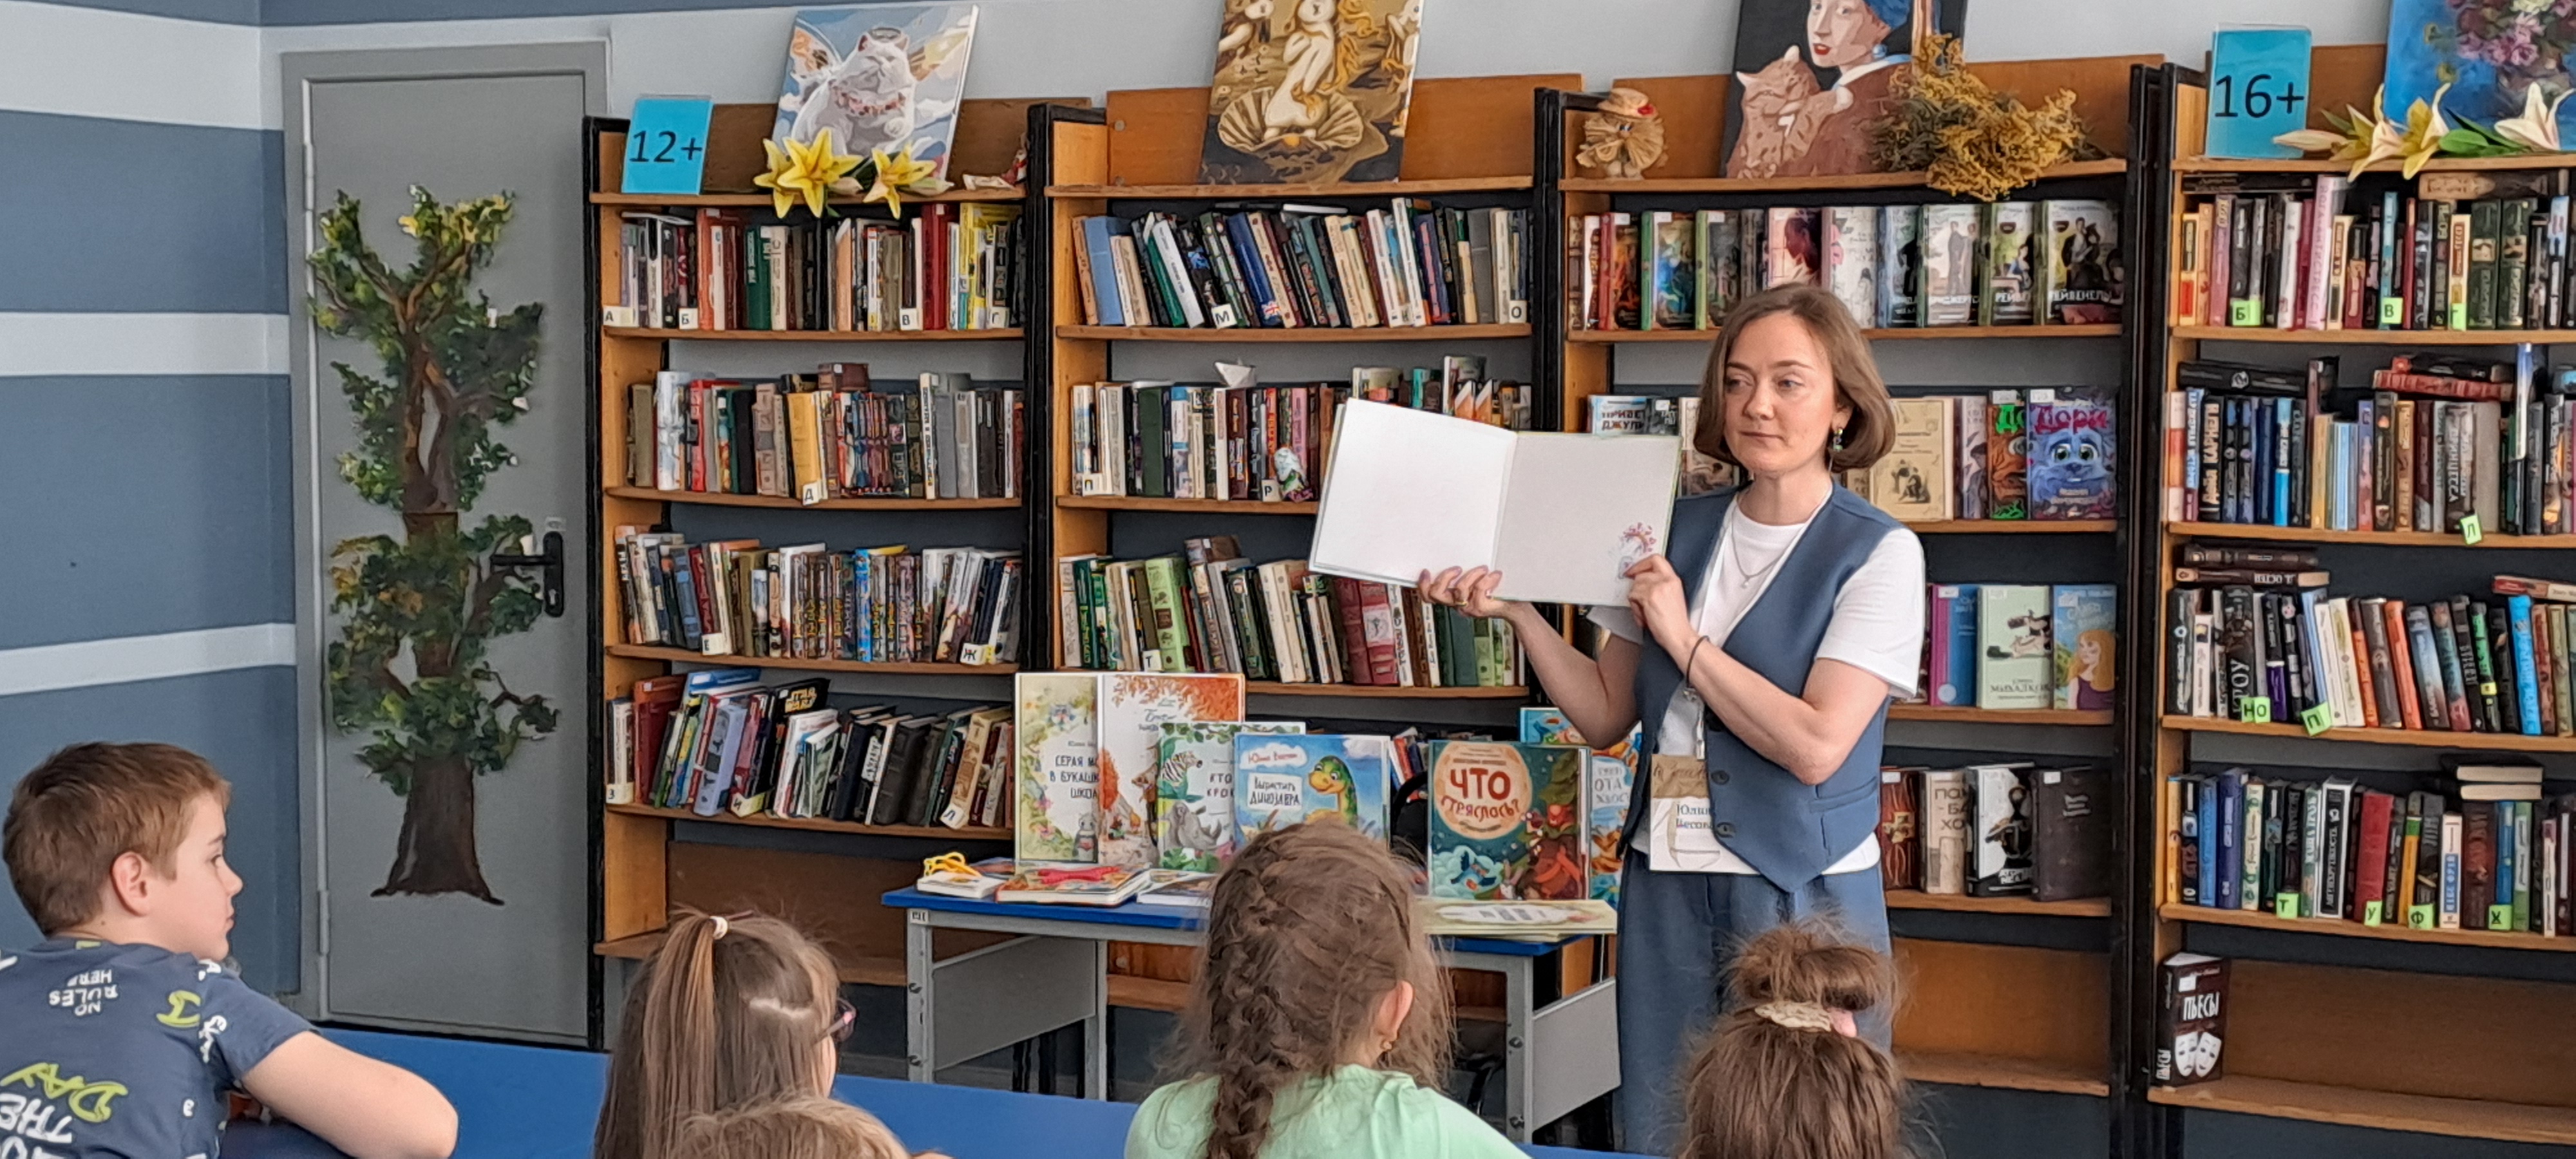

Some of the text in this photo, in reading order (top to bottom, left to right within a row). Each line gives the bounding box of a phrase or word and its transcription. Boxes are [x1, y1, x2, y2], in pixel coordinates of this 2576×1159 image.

[2214, 73, 2305, 119] 16+
[630, 130, 702, 163] 12+
[605, 310, 614, 323] А
[1215, 310, 1230, 325] М
[1511, 304, 1522, 319] О
[2235, 306, 2246, 321] Б
[2384, 303, 2394, 318] В
[681, 313, 690, 325] Б
[903, 314, 911, 326] В
[2034, 405, 2107, 435] Дори
[2203, 402, 2221, 465] КАРНЕГИ
[1084, 478, 1094, 491] П
[1264, 484, 1273, 497] Р
[2466, 523, 2476, 538] Л
[962, 646, 977, 662] Ж
[1144, 655, 1153, 669] Т
[2244, 704, 2254, 717] Н
[2257, 704, 2267, 717] О
[2307, 713, 2321, 729] П
[1050, 771, 1056, 782] В
[1209, 773, 1232, 784] КТО
[1450, 768, 1511, 801] ЧТО
[608, 787, 615, 800] З
[2278, 899, 2289, 913] Т
[2410, 909, 2424, 925] Ф
[2491, 910, 2501, 926] Х
[48, 985, 118, 1006] RULES
[74, 1001, 101, 1017] NO
[2183, 991, 2220, 1021] ПЬЕСЫ
